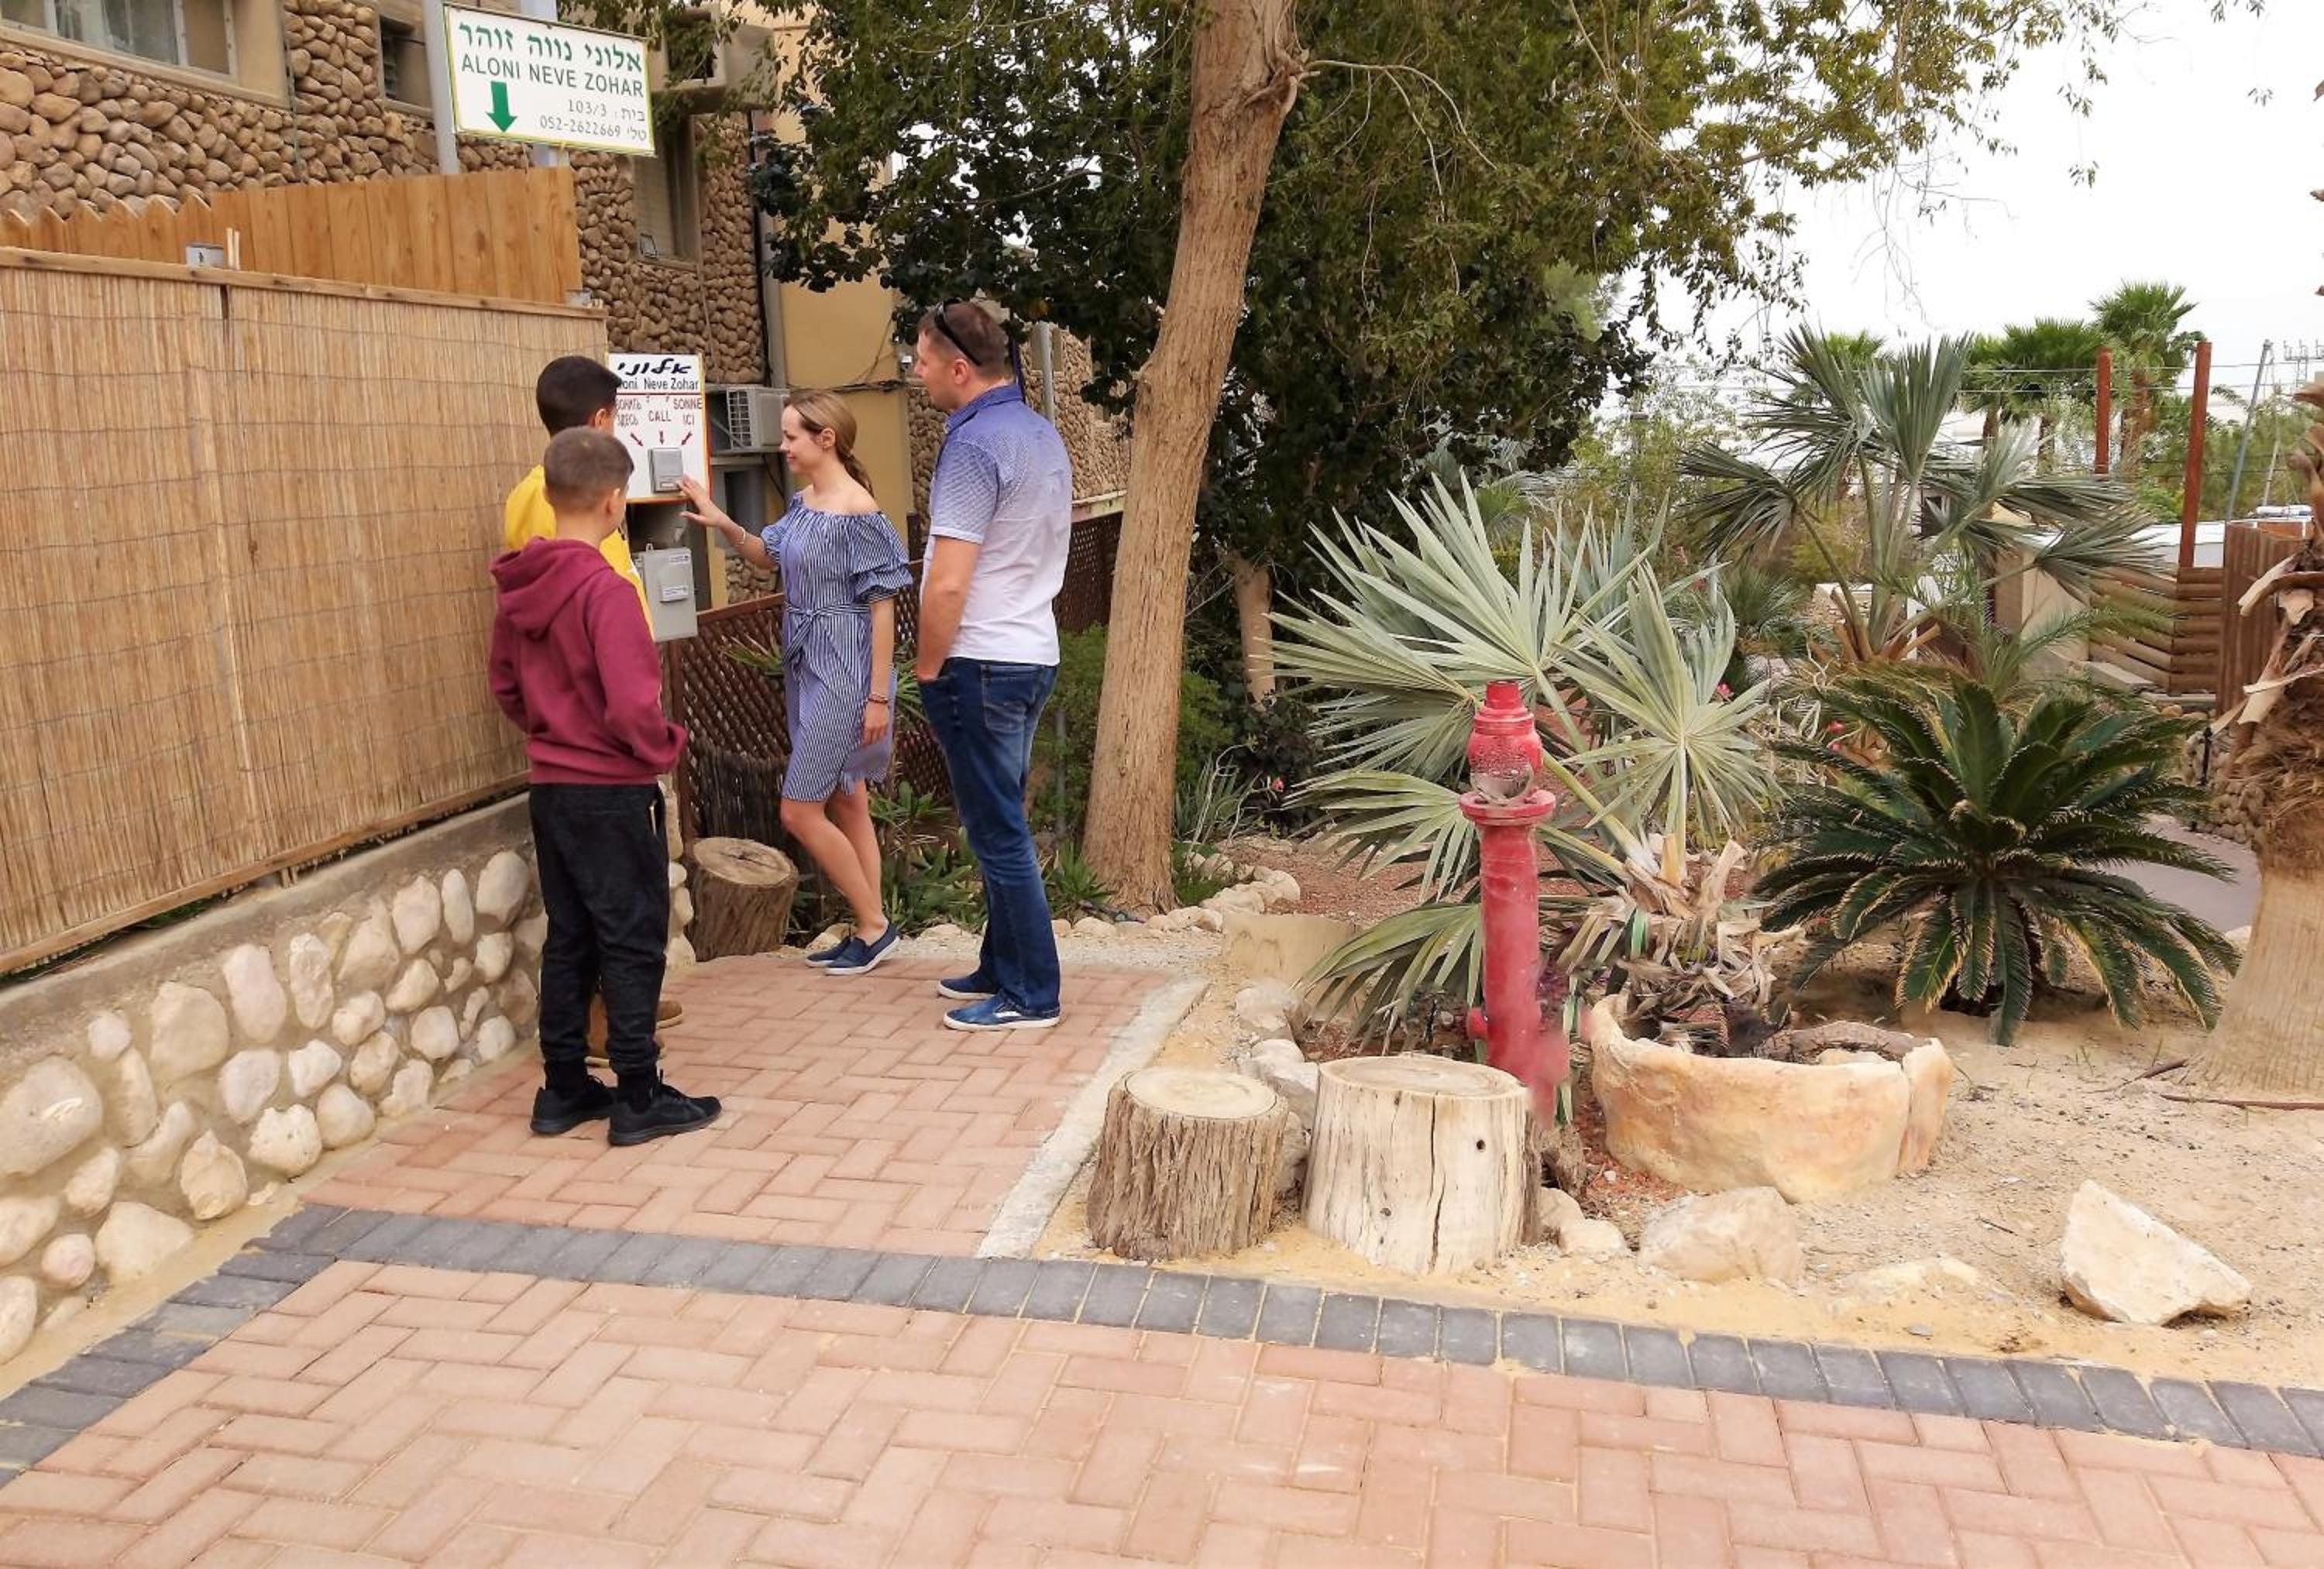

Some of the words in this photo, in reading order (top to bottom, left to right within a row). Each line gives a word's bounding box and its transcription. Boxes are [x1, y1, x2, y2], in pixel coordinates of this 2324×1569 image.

[459, 22, 514, 51] זוהר
[527, 34, 572, 61] נווה
[585, 43, 642, 72] אלוני
[462, 53, 520, 80] ALONI
[529, 64, 577, 88] NEVE
[585, 72, 644, 98] ZOHAR
[569, 99, 607, 117] 103/3
[617, 358, 692, 376] אלוני
[620, 377, 638, 390] oni
[644, 377, 669, 390] Neve
[670, 377, 699, 390] Zohar
[673, 397, 703, 410] SONNE
[648, 410, 672, 422] CALL
